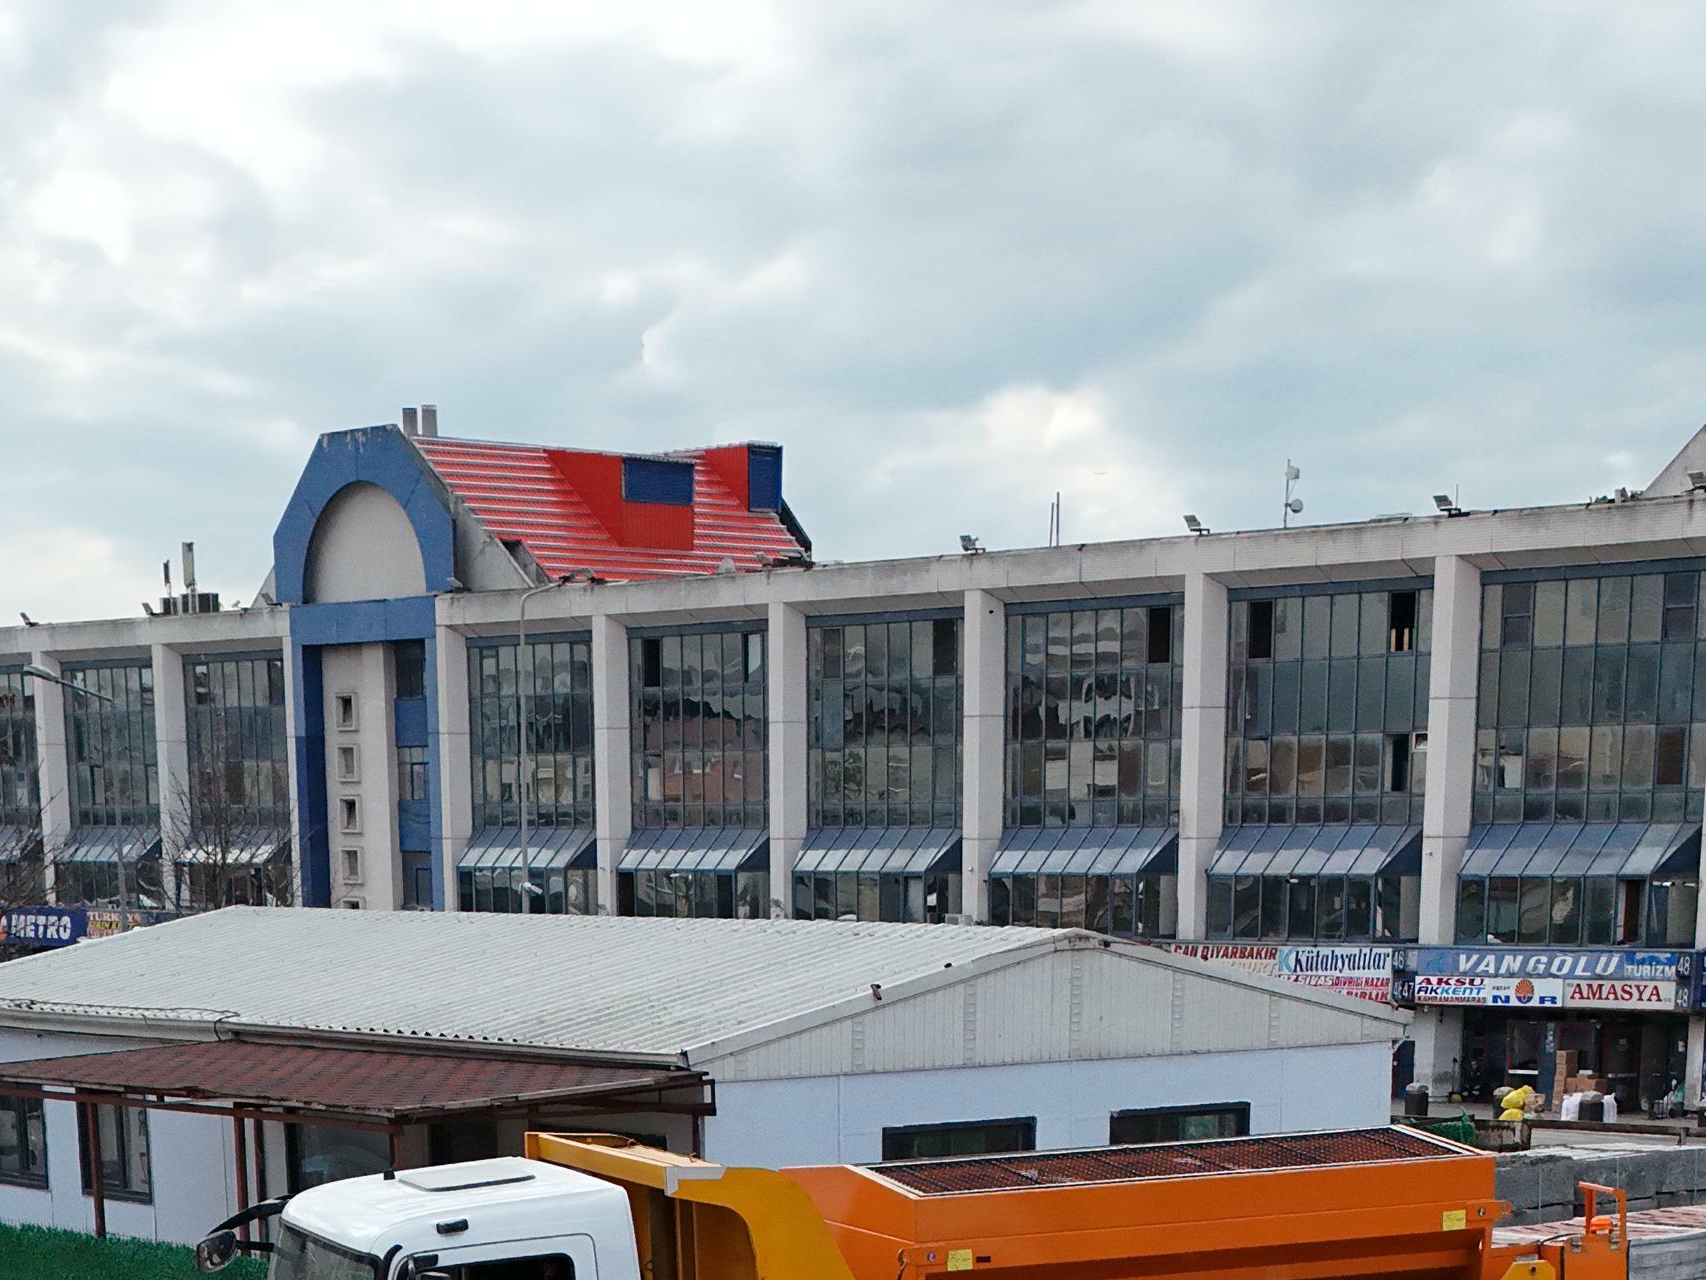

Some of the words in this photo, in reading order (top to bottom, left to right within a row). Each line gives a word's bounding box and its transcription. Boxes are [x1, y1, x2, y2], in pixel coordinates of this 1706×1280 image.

[1293, 948, 1389, 974] Kütahyalılar
[1458, 952, 1621, 976] VANGÖLÜ
[1625, 962, 1676, 978] TURİZM
[1677, 956, 1690, 975] 48
[1416, 986, 1486, 995] AKKENT
[1417, 977, 1485, 986] AKSU
[1570, 983, 1663, 1002] AMASYA
[1676, 988, 1689, 1008] 48
